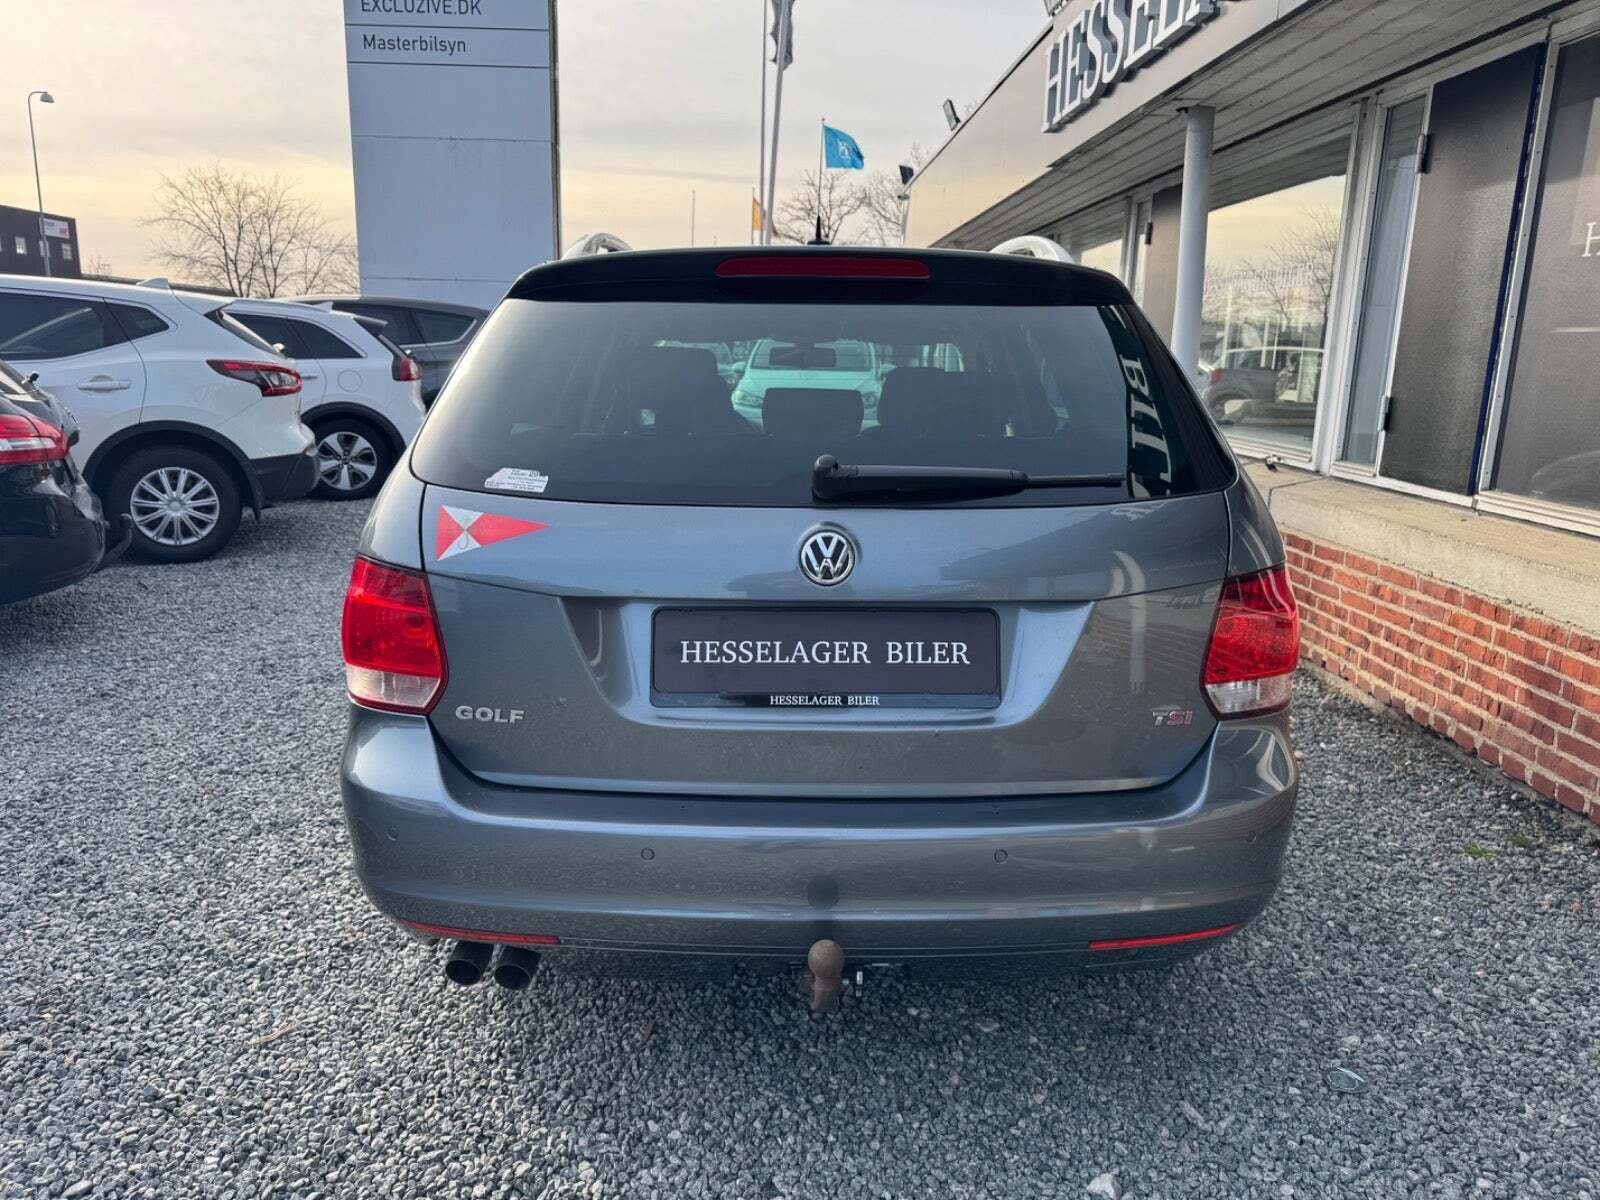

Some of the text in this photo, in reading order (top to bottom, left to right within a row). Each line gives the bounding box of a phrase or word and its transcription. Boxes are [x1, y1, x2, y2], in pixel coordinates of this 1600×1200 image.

[361, 0, 482, 15] EXCLUZIVE.DK
[363, 34, 466, 56] Masterbilsyn
[680, 640, 971, 664] HESSELAGER BILER
[770, 695, 880, 706] HESSELAGER BILER
[455, 705, 525, 723] GOLF
[1152, 710, 1193, 726] TSI
